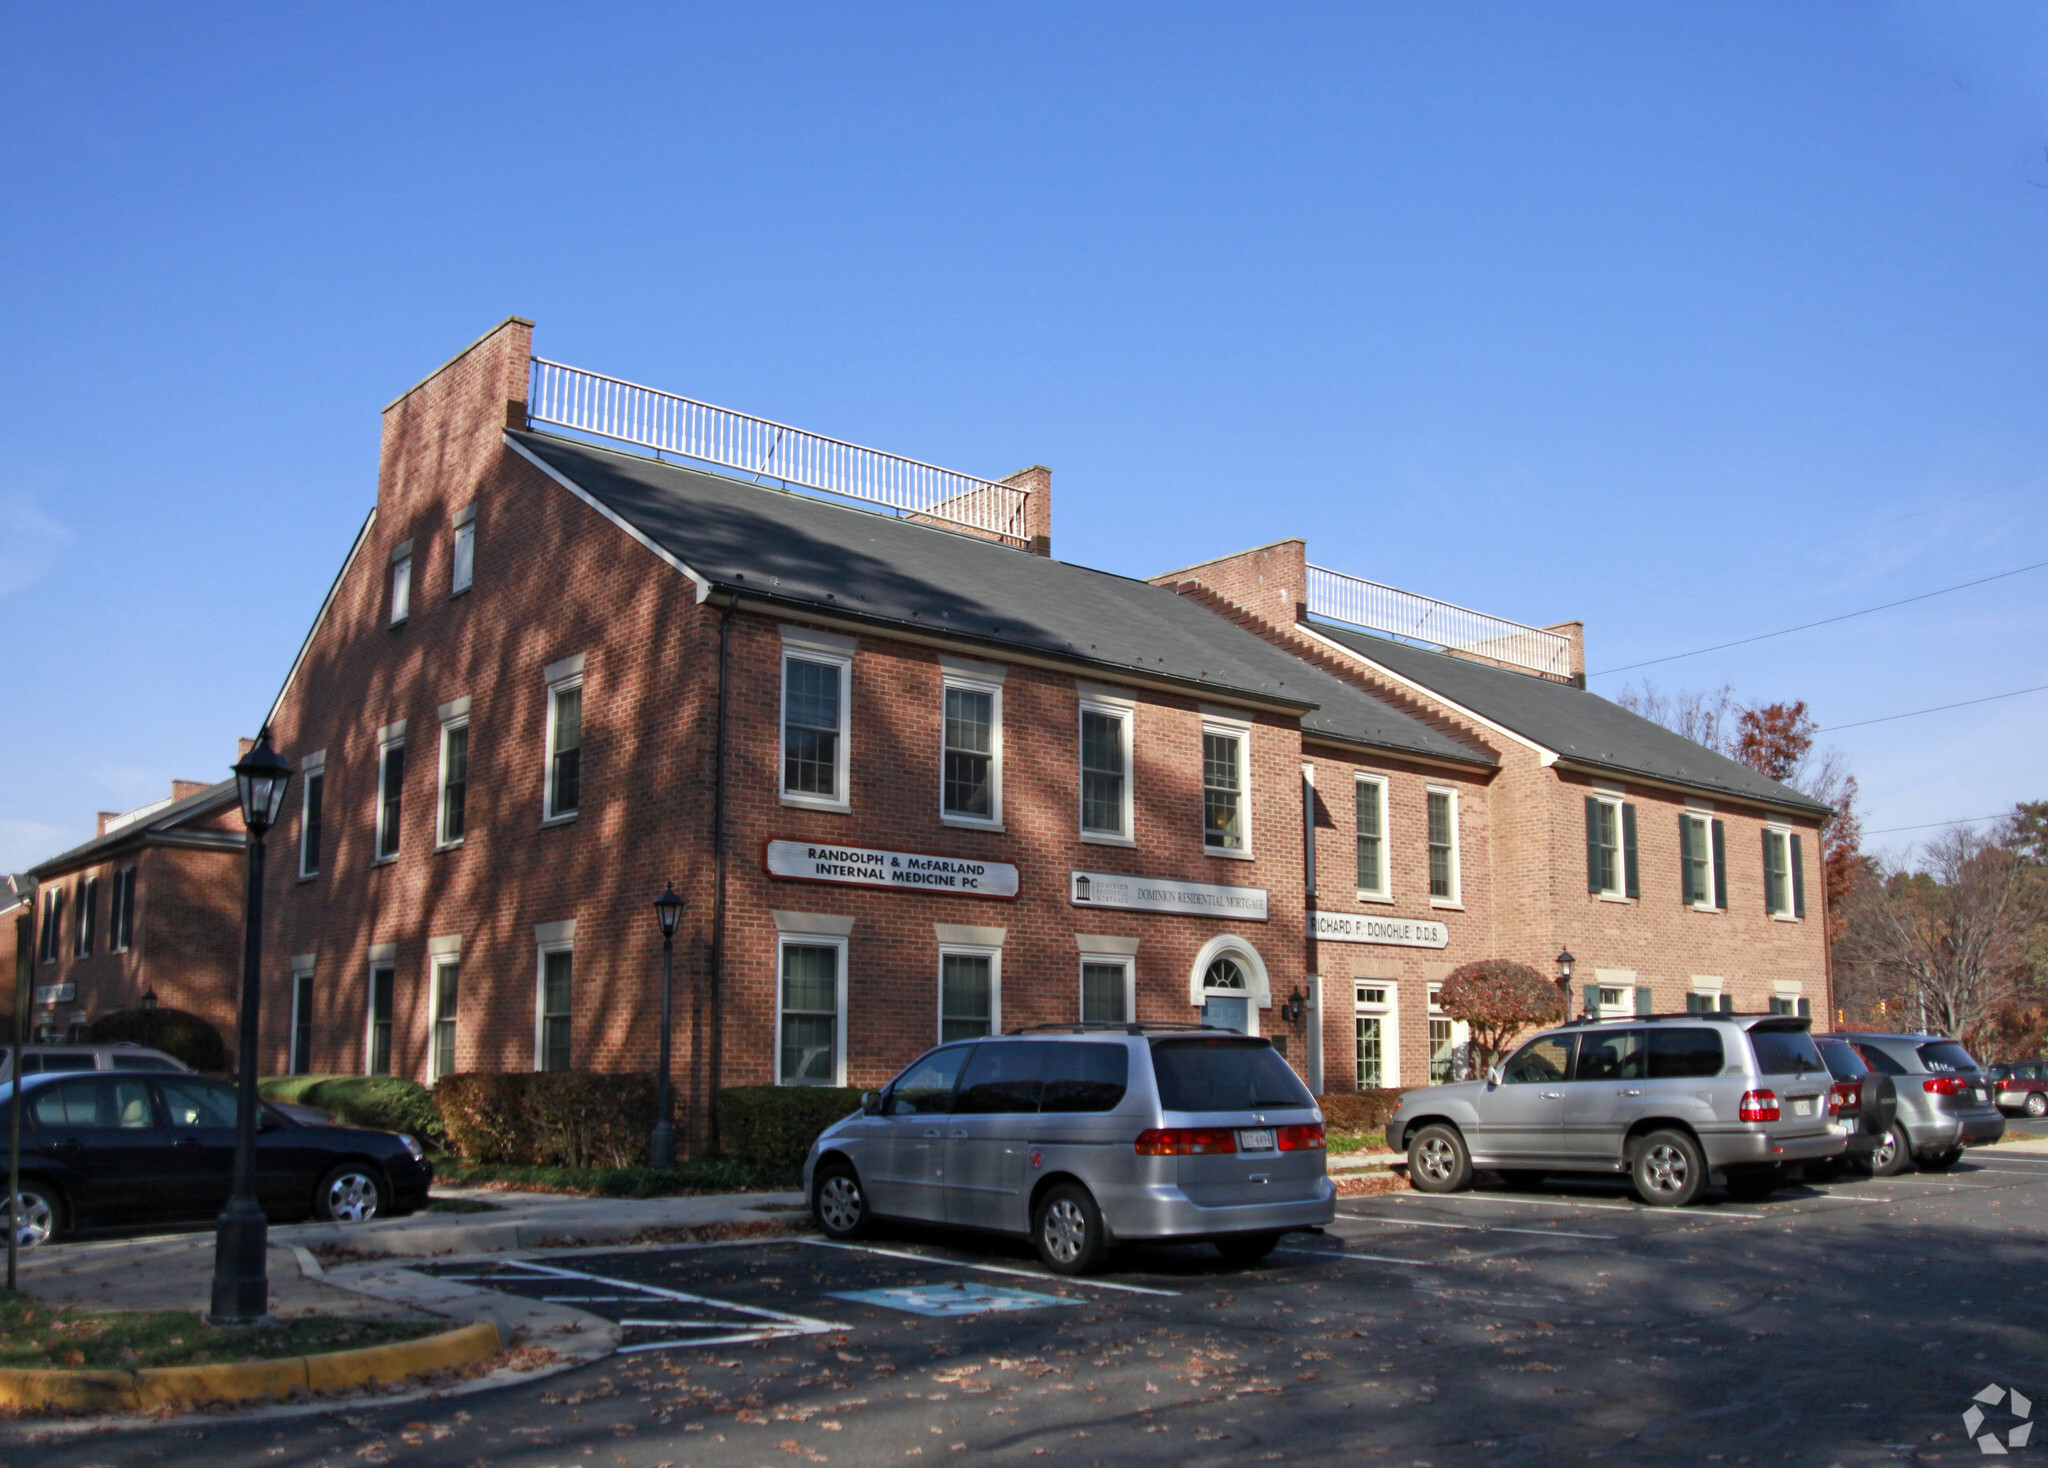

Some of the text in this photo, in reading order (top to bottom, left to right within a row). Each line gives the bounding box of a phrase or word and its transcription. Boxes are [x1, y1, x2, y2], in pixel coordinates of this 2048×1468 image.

[808, 847, 985, 876] RANDOLPH & McFARLAND
[815, 863, 978, 889] INTERNAL MEDICINE PC
[1138, 888, 1265, 910] DOMINION RESIDENTIAL MORTGAGE
[1311, 917, 1352, 935] RICHARD
[1356, 921, 1364, 936] F.
